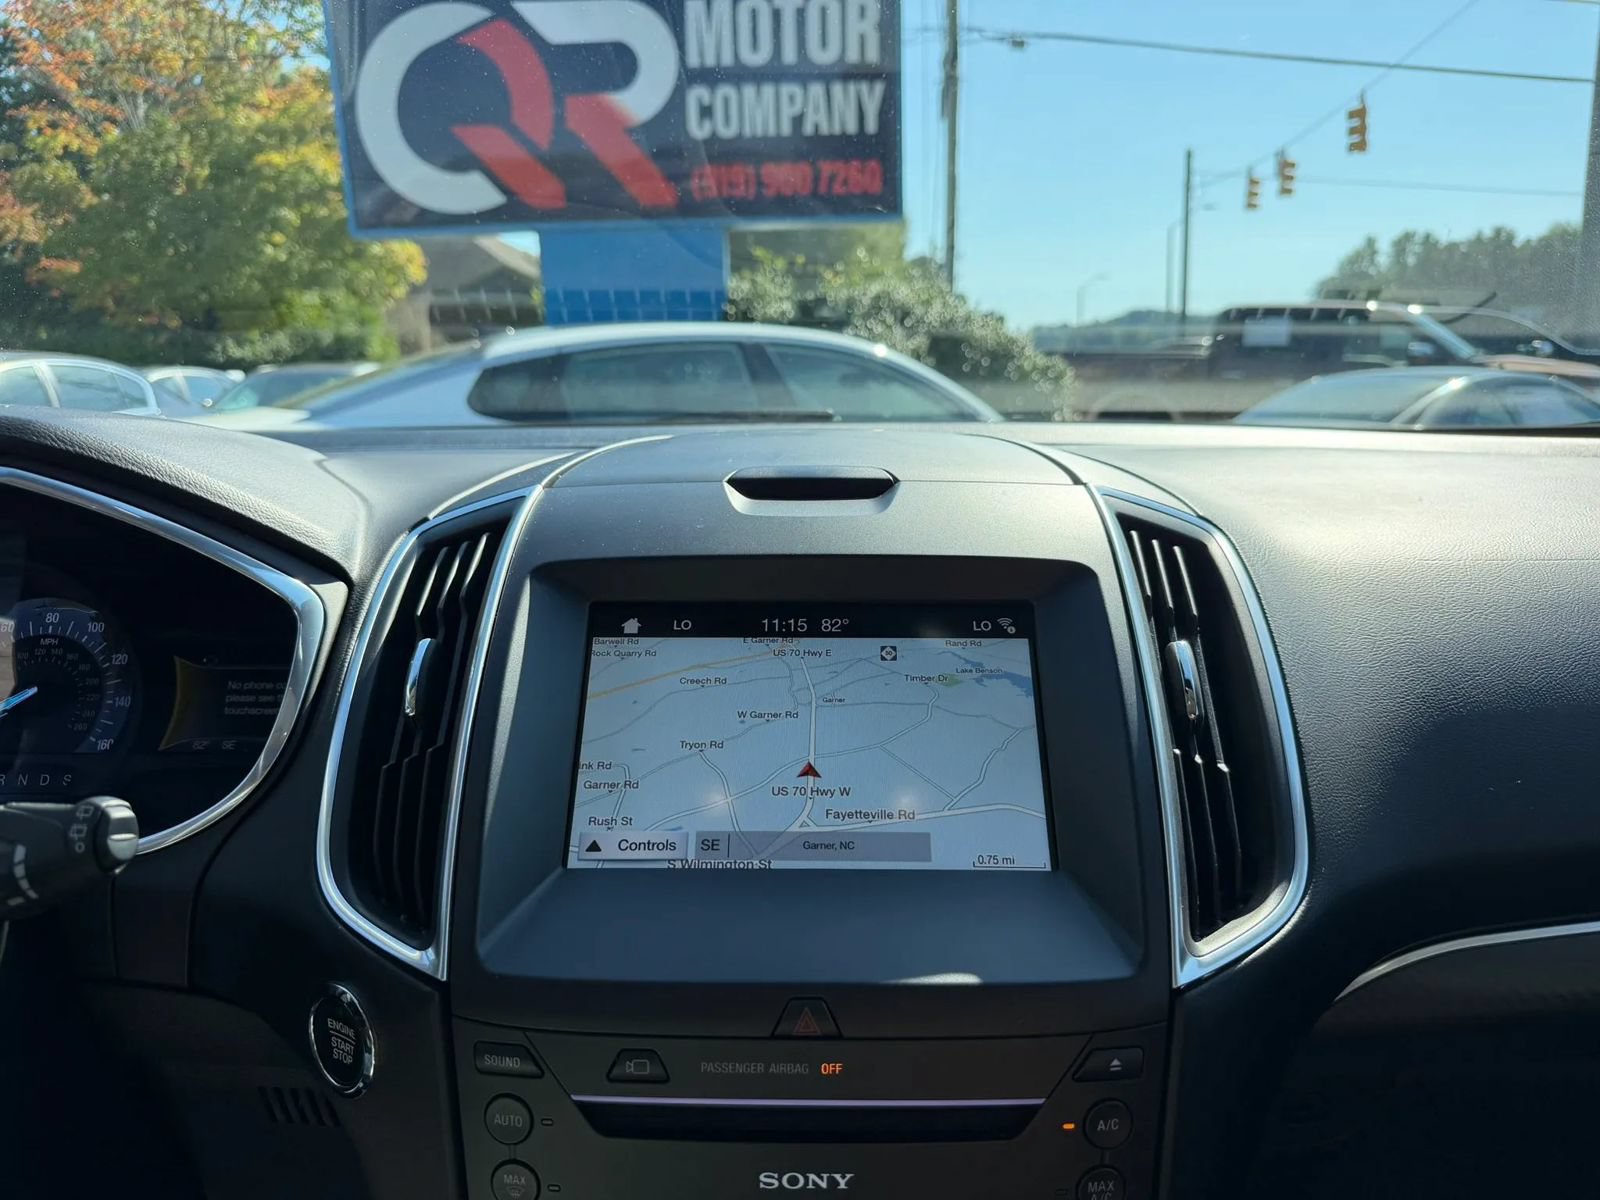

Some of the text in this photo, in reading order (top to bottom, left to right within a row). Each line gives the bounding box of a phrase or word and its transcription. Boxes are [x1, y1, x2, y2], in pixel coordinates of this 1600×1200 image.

[685, 0, 881, 68] MOTOR
[685, 80, 886, 139] COMPANY
[45, 612, 60, 623] 80
[87, 622, 105, 633] 100
[673, 618, 992, 632] LO 11:15 82° LO
[40, 637, 59, 646] MPH
[112, 654, 128, 664] 120
[613, 650, 643, 659] Quarry
[773, 648, 832, 659] US 70 Hwy E
[679, 676, 727, 685] Creech Rd
[904, 674, 948, 683] Timber Dr
[114, 696, 131, 707] 140
[737, 710, 799, 719] W Garner Rd
[680, 741, 724, 750] Tryon Rd
[597, 761, 612, 770] Rd
[18, 774, 29, 785] N
[39, 774, 50, 785] D
[62, 774, 73, 785] S
[583, 780, 639, 790] Garner Rd
[771, 786, 851, 798] US 70 Hwy W
[825, 808, 916, 822] Fayetteville Rd
[588, 816, 633, 826] Rush St
[617, 838, 677, 852] Controls
[700, 838, 721, 851] SE
[802, 841, 855, 851] Garner, NC
[667, 858, 772, 869] S Wilmington St
[977, 854, 1015, 865] 0.75 mi
[327, 1017, 357, 1040] ENGINE
[331, 1036, 355, 1056] START
[332, 1047, 353, 1065] STOP
[484, 1053, 521, 1068] SOUND
[700, 1062, 843, 1075] PASSENGER AIRBAG OFF
[494, 1113, 523, 1127] AUTO
[1096, 1118, 1120, 1132] A/C
[503, 1174, 526, 1185] MAX
[758, 1171, 855, 1190] SONY
[1087, 1180, 1115, 1193] MAX
